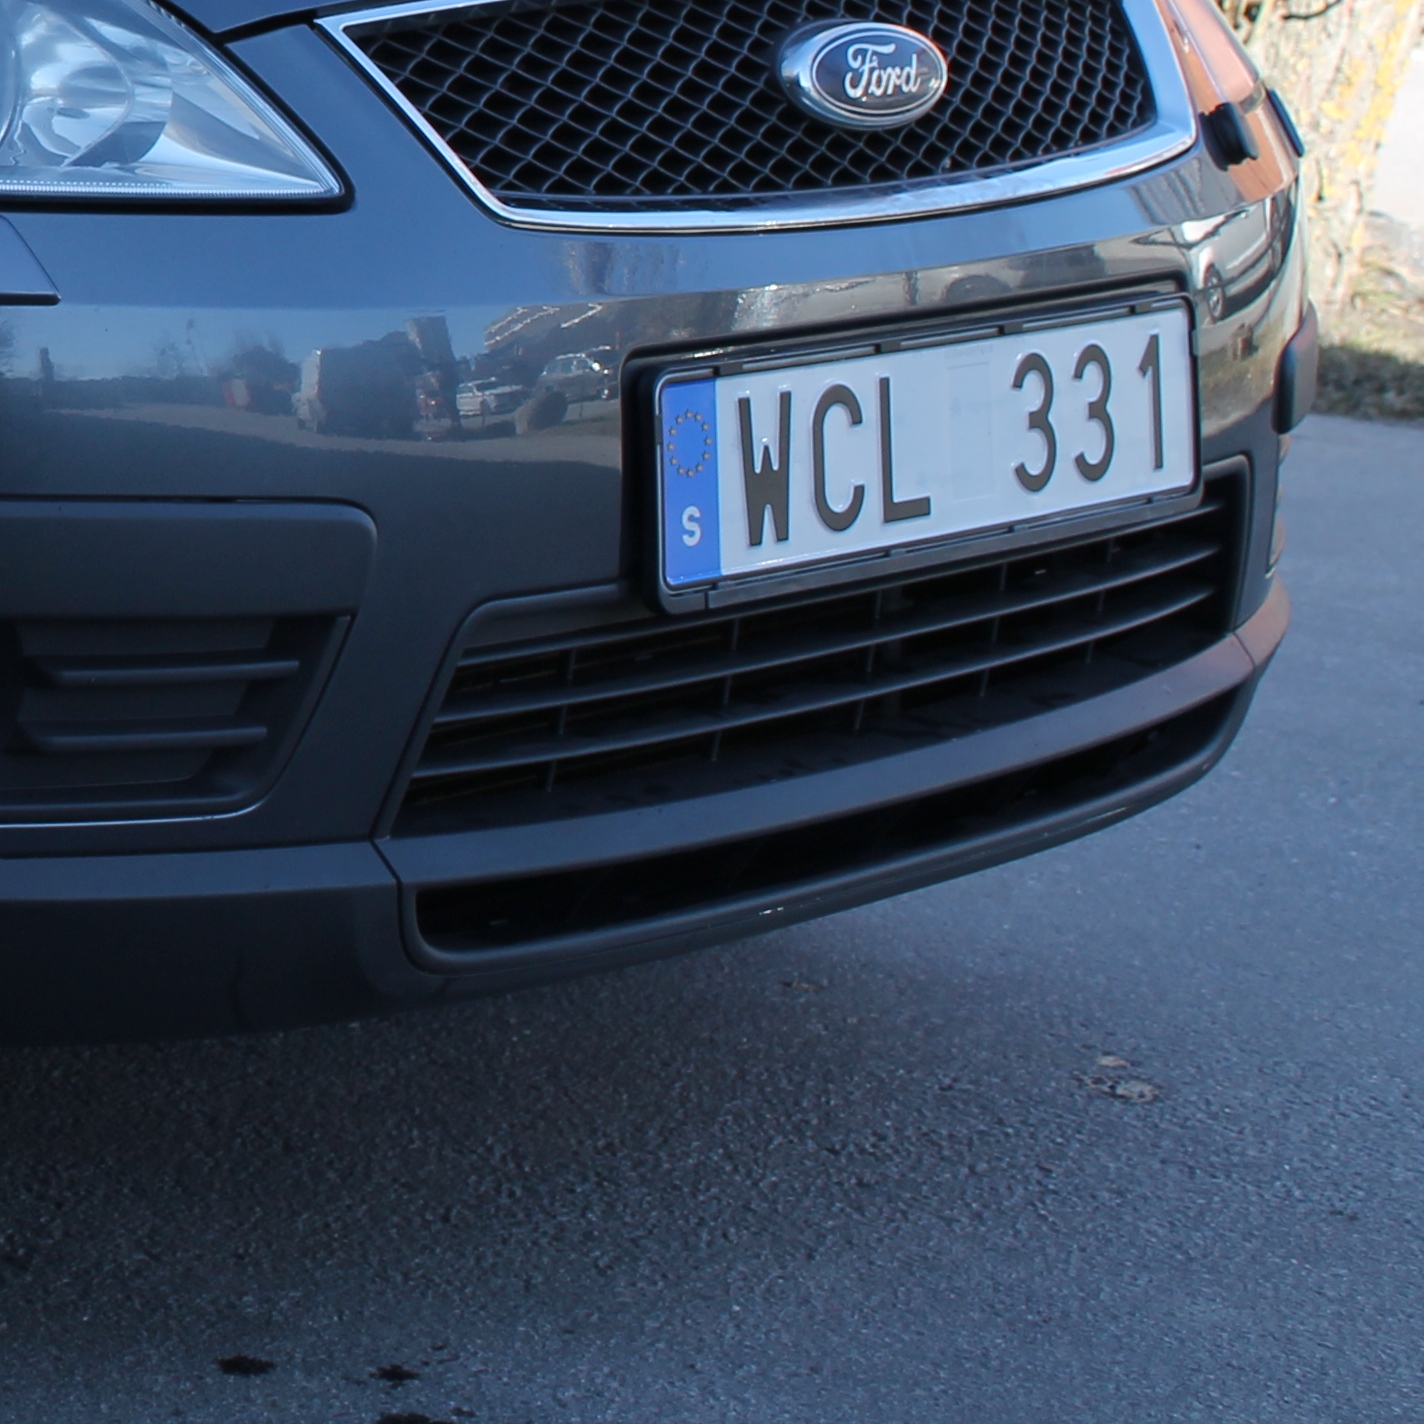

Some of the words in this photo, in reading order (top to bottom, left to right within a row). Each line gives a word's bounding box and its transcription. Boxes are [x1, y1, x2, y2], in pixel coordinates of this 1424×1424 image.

[843, 43, 922, 99] Ford
[738, 376, 931, 547] WCL
[1011, 332, 1165, 493] 331
[681, 505, 703, 548] S
